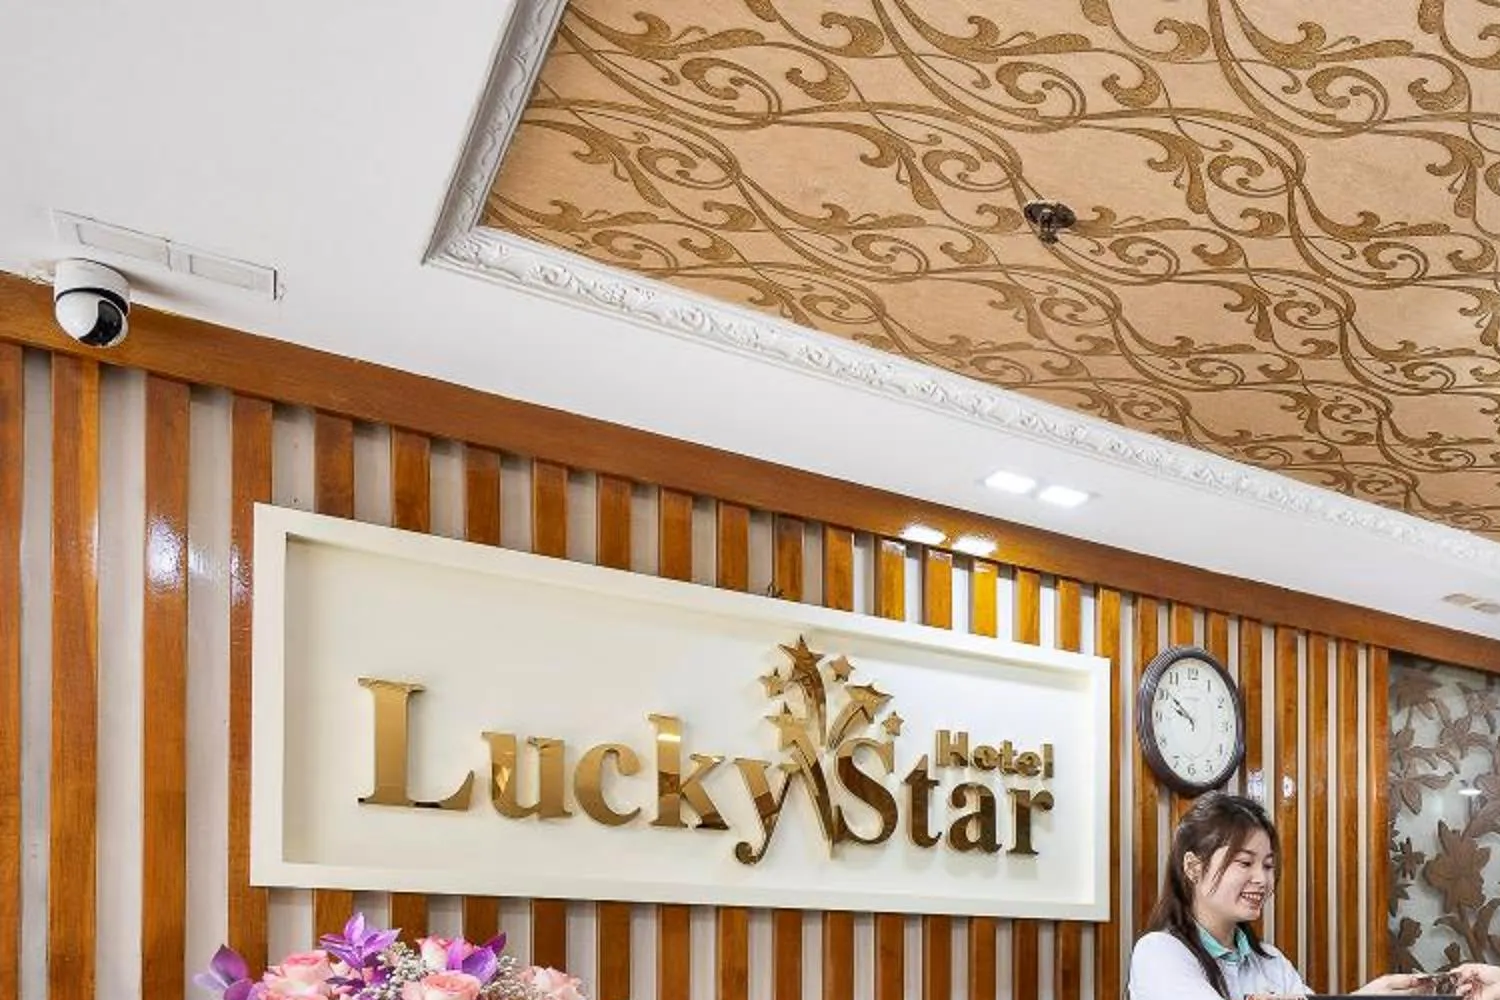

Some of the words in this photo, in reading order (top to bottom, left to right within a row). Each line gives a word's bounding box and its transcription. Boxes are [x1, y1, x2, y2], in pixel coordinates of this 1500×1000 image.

[1169, 671, 1179, 685] 11
[1187, 667, 1198, 681] 12
[1207, 679, 1211, 693] 1
[1218, 697, 1225, 709] 2
[935, 729, 1054, 778] Hotel
[358, 676, 800, 865] Lucky
[833, 738, 1055, 855] Star
[1187, 762, 1196, 776] 6
